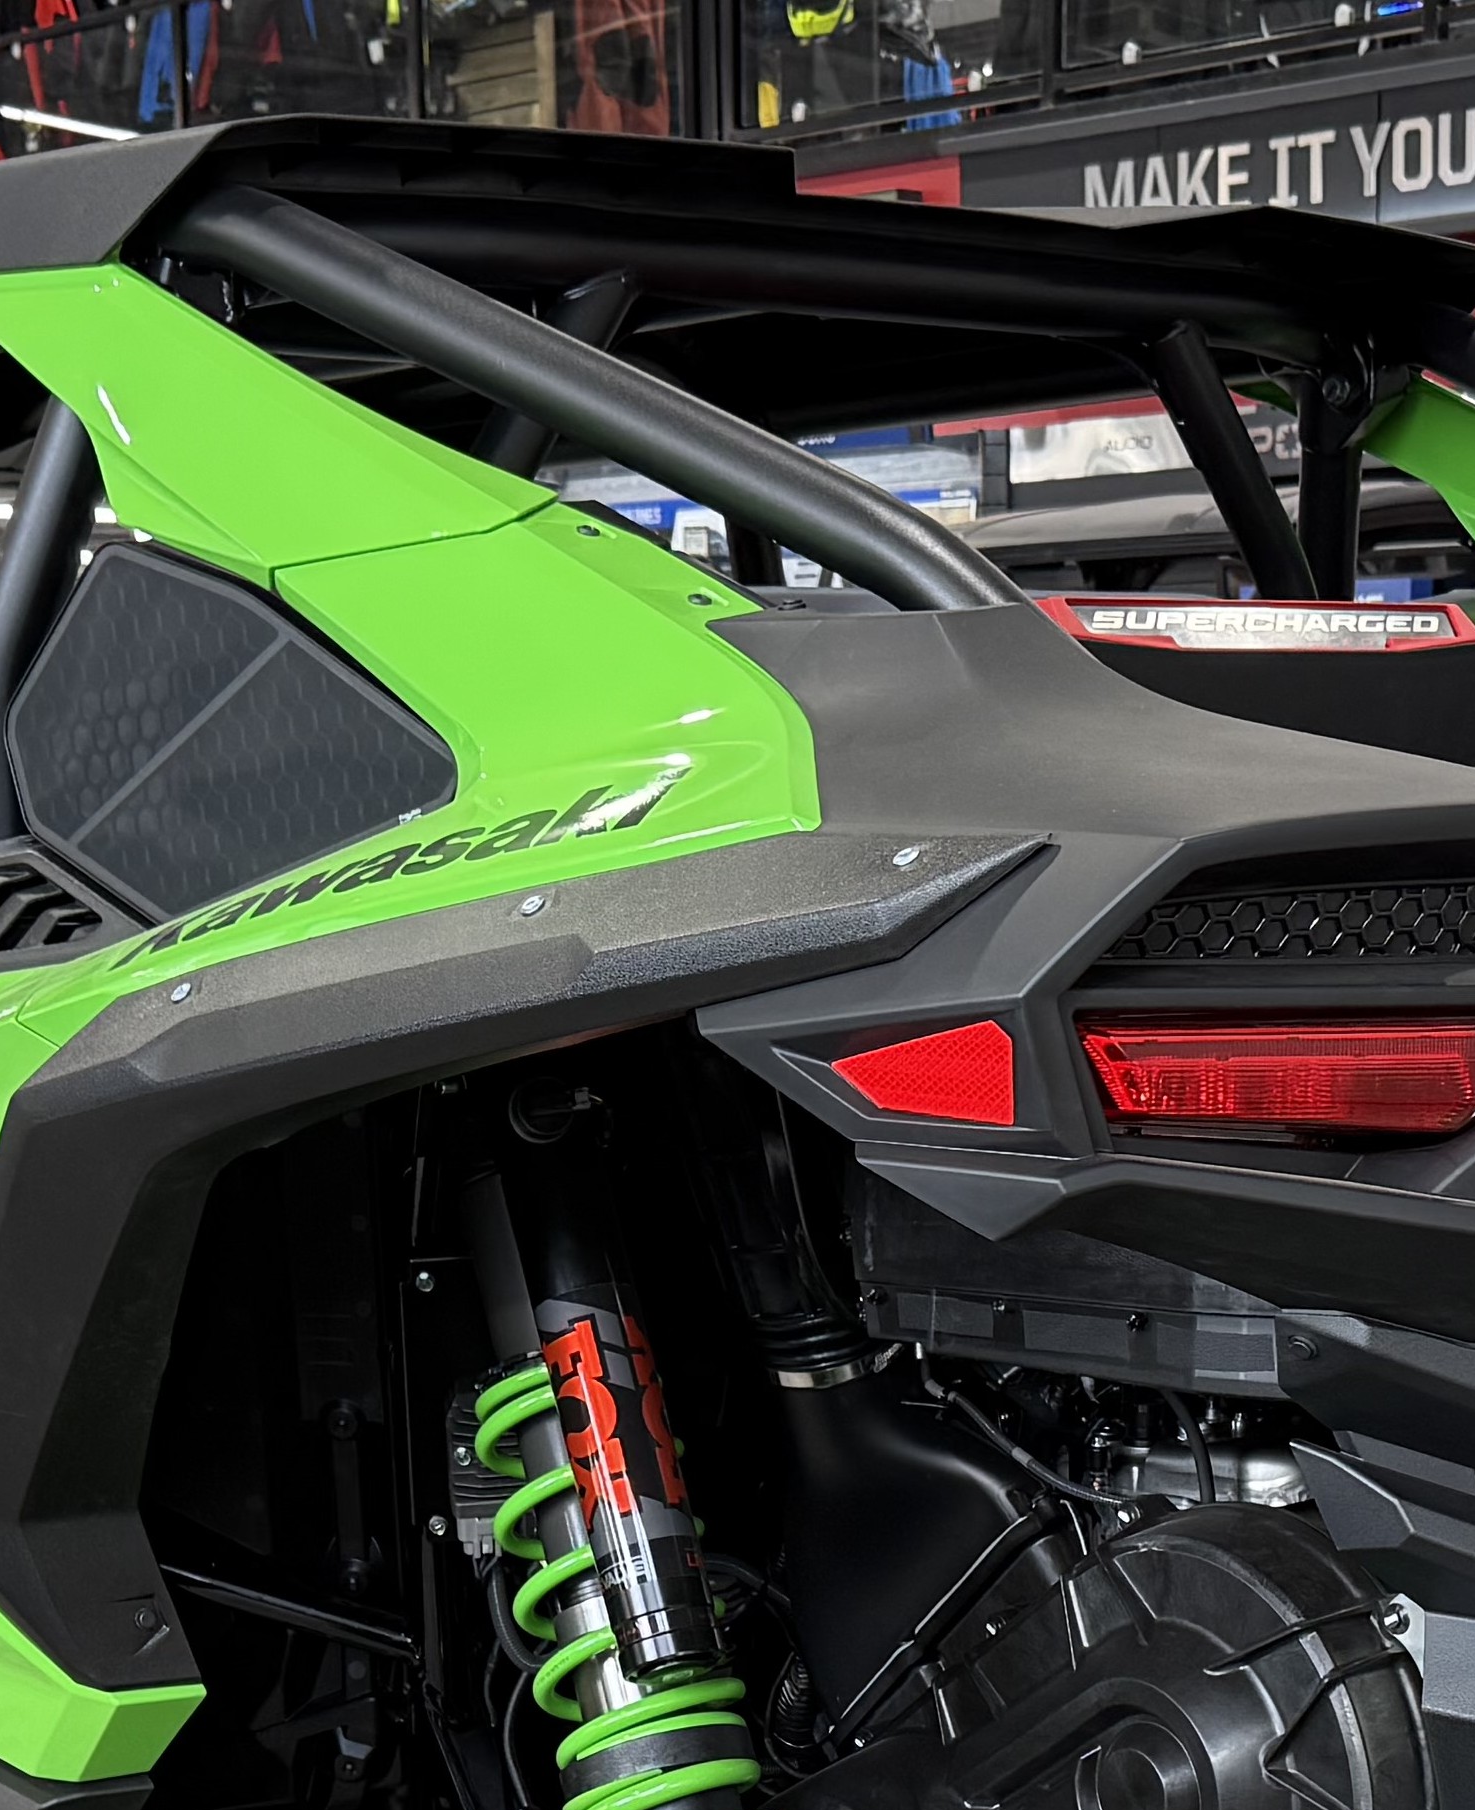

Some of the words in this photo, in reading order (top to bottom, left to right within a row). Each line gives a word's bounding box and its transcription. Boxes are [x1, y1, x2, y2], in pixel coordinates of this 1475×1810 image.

[1083, 143, 1252, 208] MAKE
[1268, 130, 1336, 207] IT
[1091, 609, 1441, 634] SUPERCHARGED
[108, 766, 694, 971] Kawasaki
[542, 1319, 633, 1532] FOX
